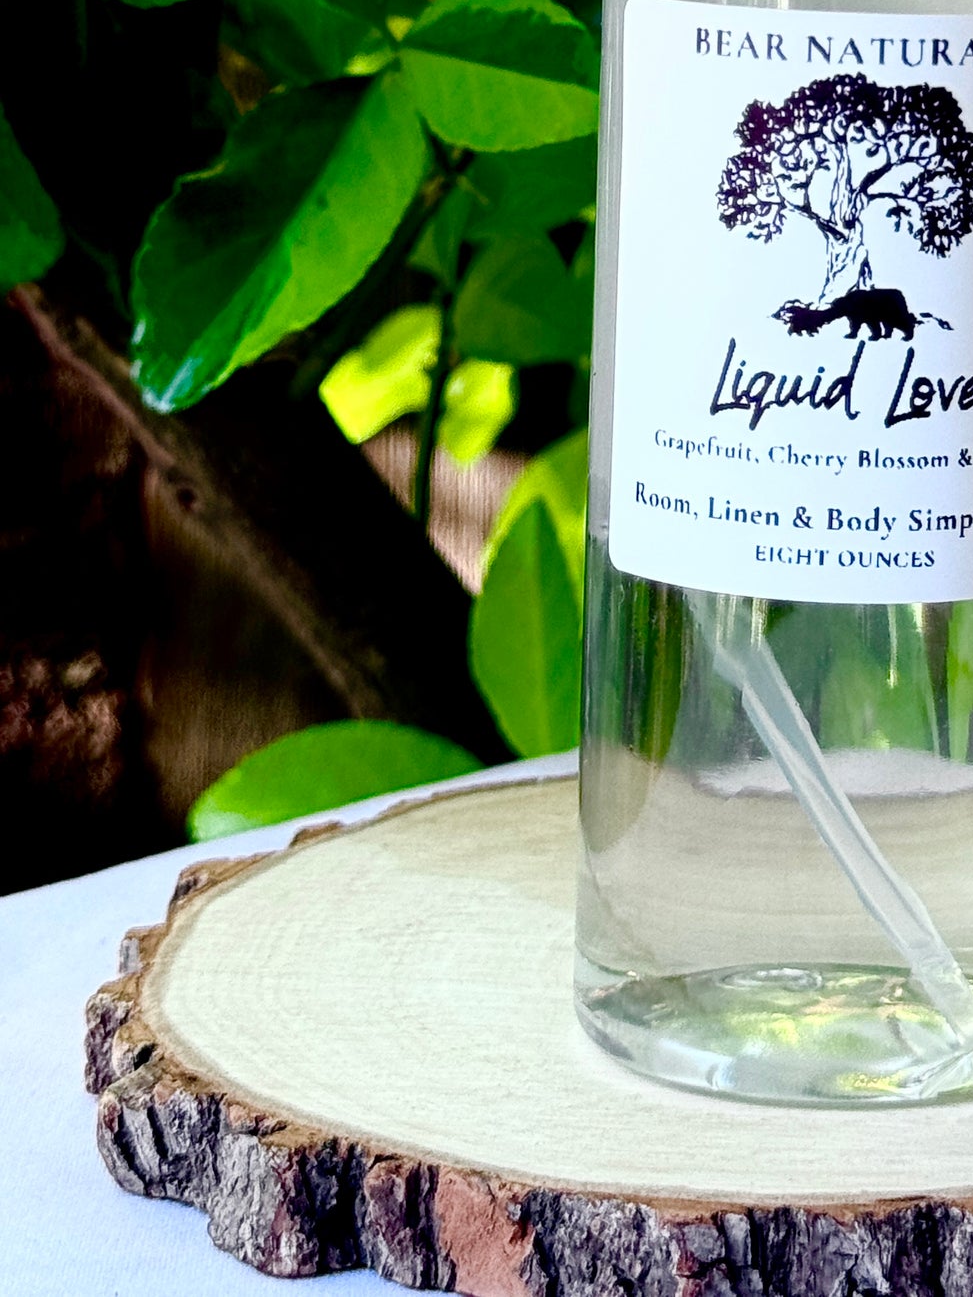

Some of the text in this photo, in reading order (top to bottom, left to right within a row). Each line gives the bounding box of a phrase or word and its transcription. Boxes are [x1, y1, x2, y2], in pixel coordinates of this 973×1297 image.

[695, 27, 788, 61] BEAR
[709, 337, 865, 431] Liquid
[654, 429, 759, 464] Grapefruit,
[768, 445, 847, 475] Cherry
[858, 450, 949, 469] Blossom
[957, 448, 972, 467] &
[635, 481, 699, 520] Room,
[708, 497, 779, 527] Linen
[792, 506, 814, 529] &
[826, 508, 896, 540] Body
[755, 545, 936, 569] EIGHT OUNCES
